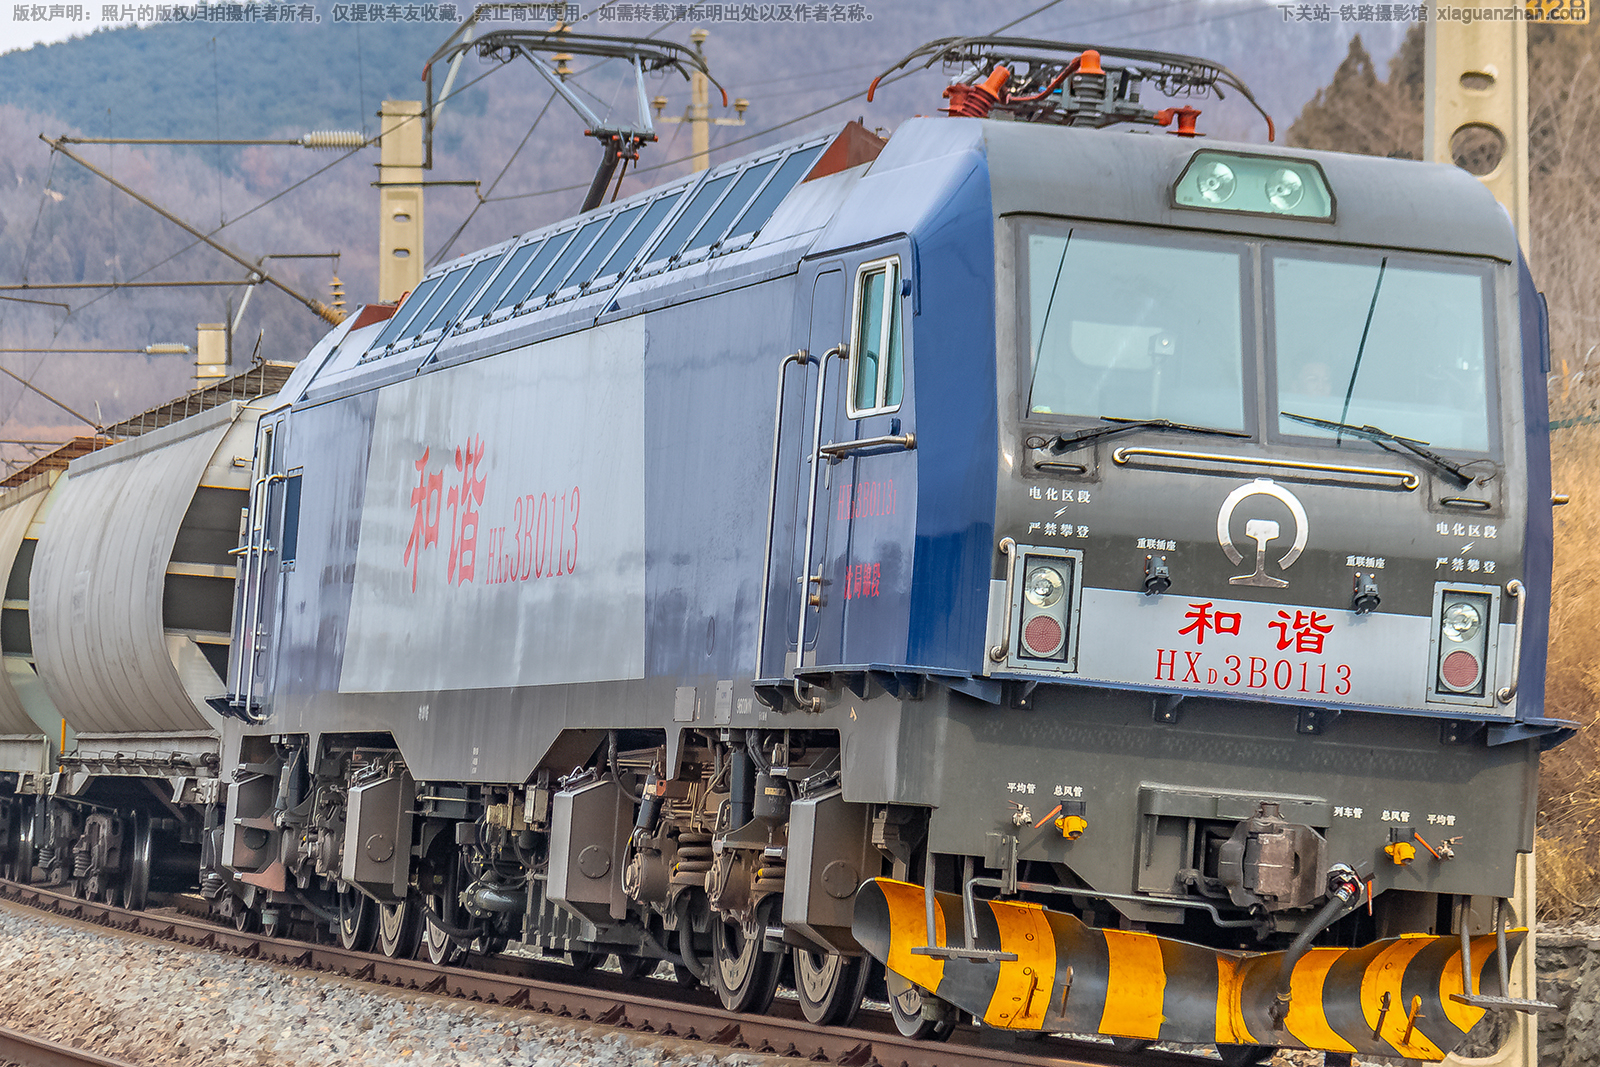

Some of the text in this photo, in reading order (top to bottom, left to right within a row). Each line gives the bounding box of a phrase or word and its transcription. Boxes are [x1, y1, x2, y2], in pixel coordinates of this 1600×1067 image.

[1029, 486, 1091, 504] 电化区段
[403, 432, 487, 593] 和谐
[1027, 521, 1090, 539] 严禁攀登
[1436, 521, 1498, 539] 电化区段
[1136, 537, 1177, 552] 重联插座
[1345, 555, 1386, 570] 重联插座
[1434, 557, 1497, 575] 严禁攀登
[1178, 602, 1334, 654] 和谐
[1154, 648, 1352, 696] HXD3B0113
[1007, 782, 1037, 795] 平均管
[1053, 785, 1083, 797] 总风管
[1333, 806, 1363, 819] 列车管
[1381, 810, 1411, 823] 总风管
[1427, 814, 1456, 826] 平均管
